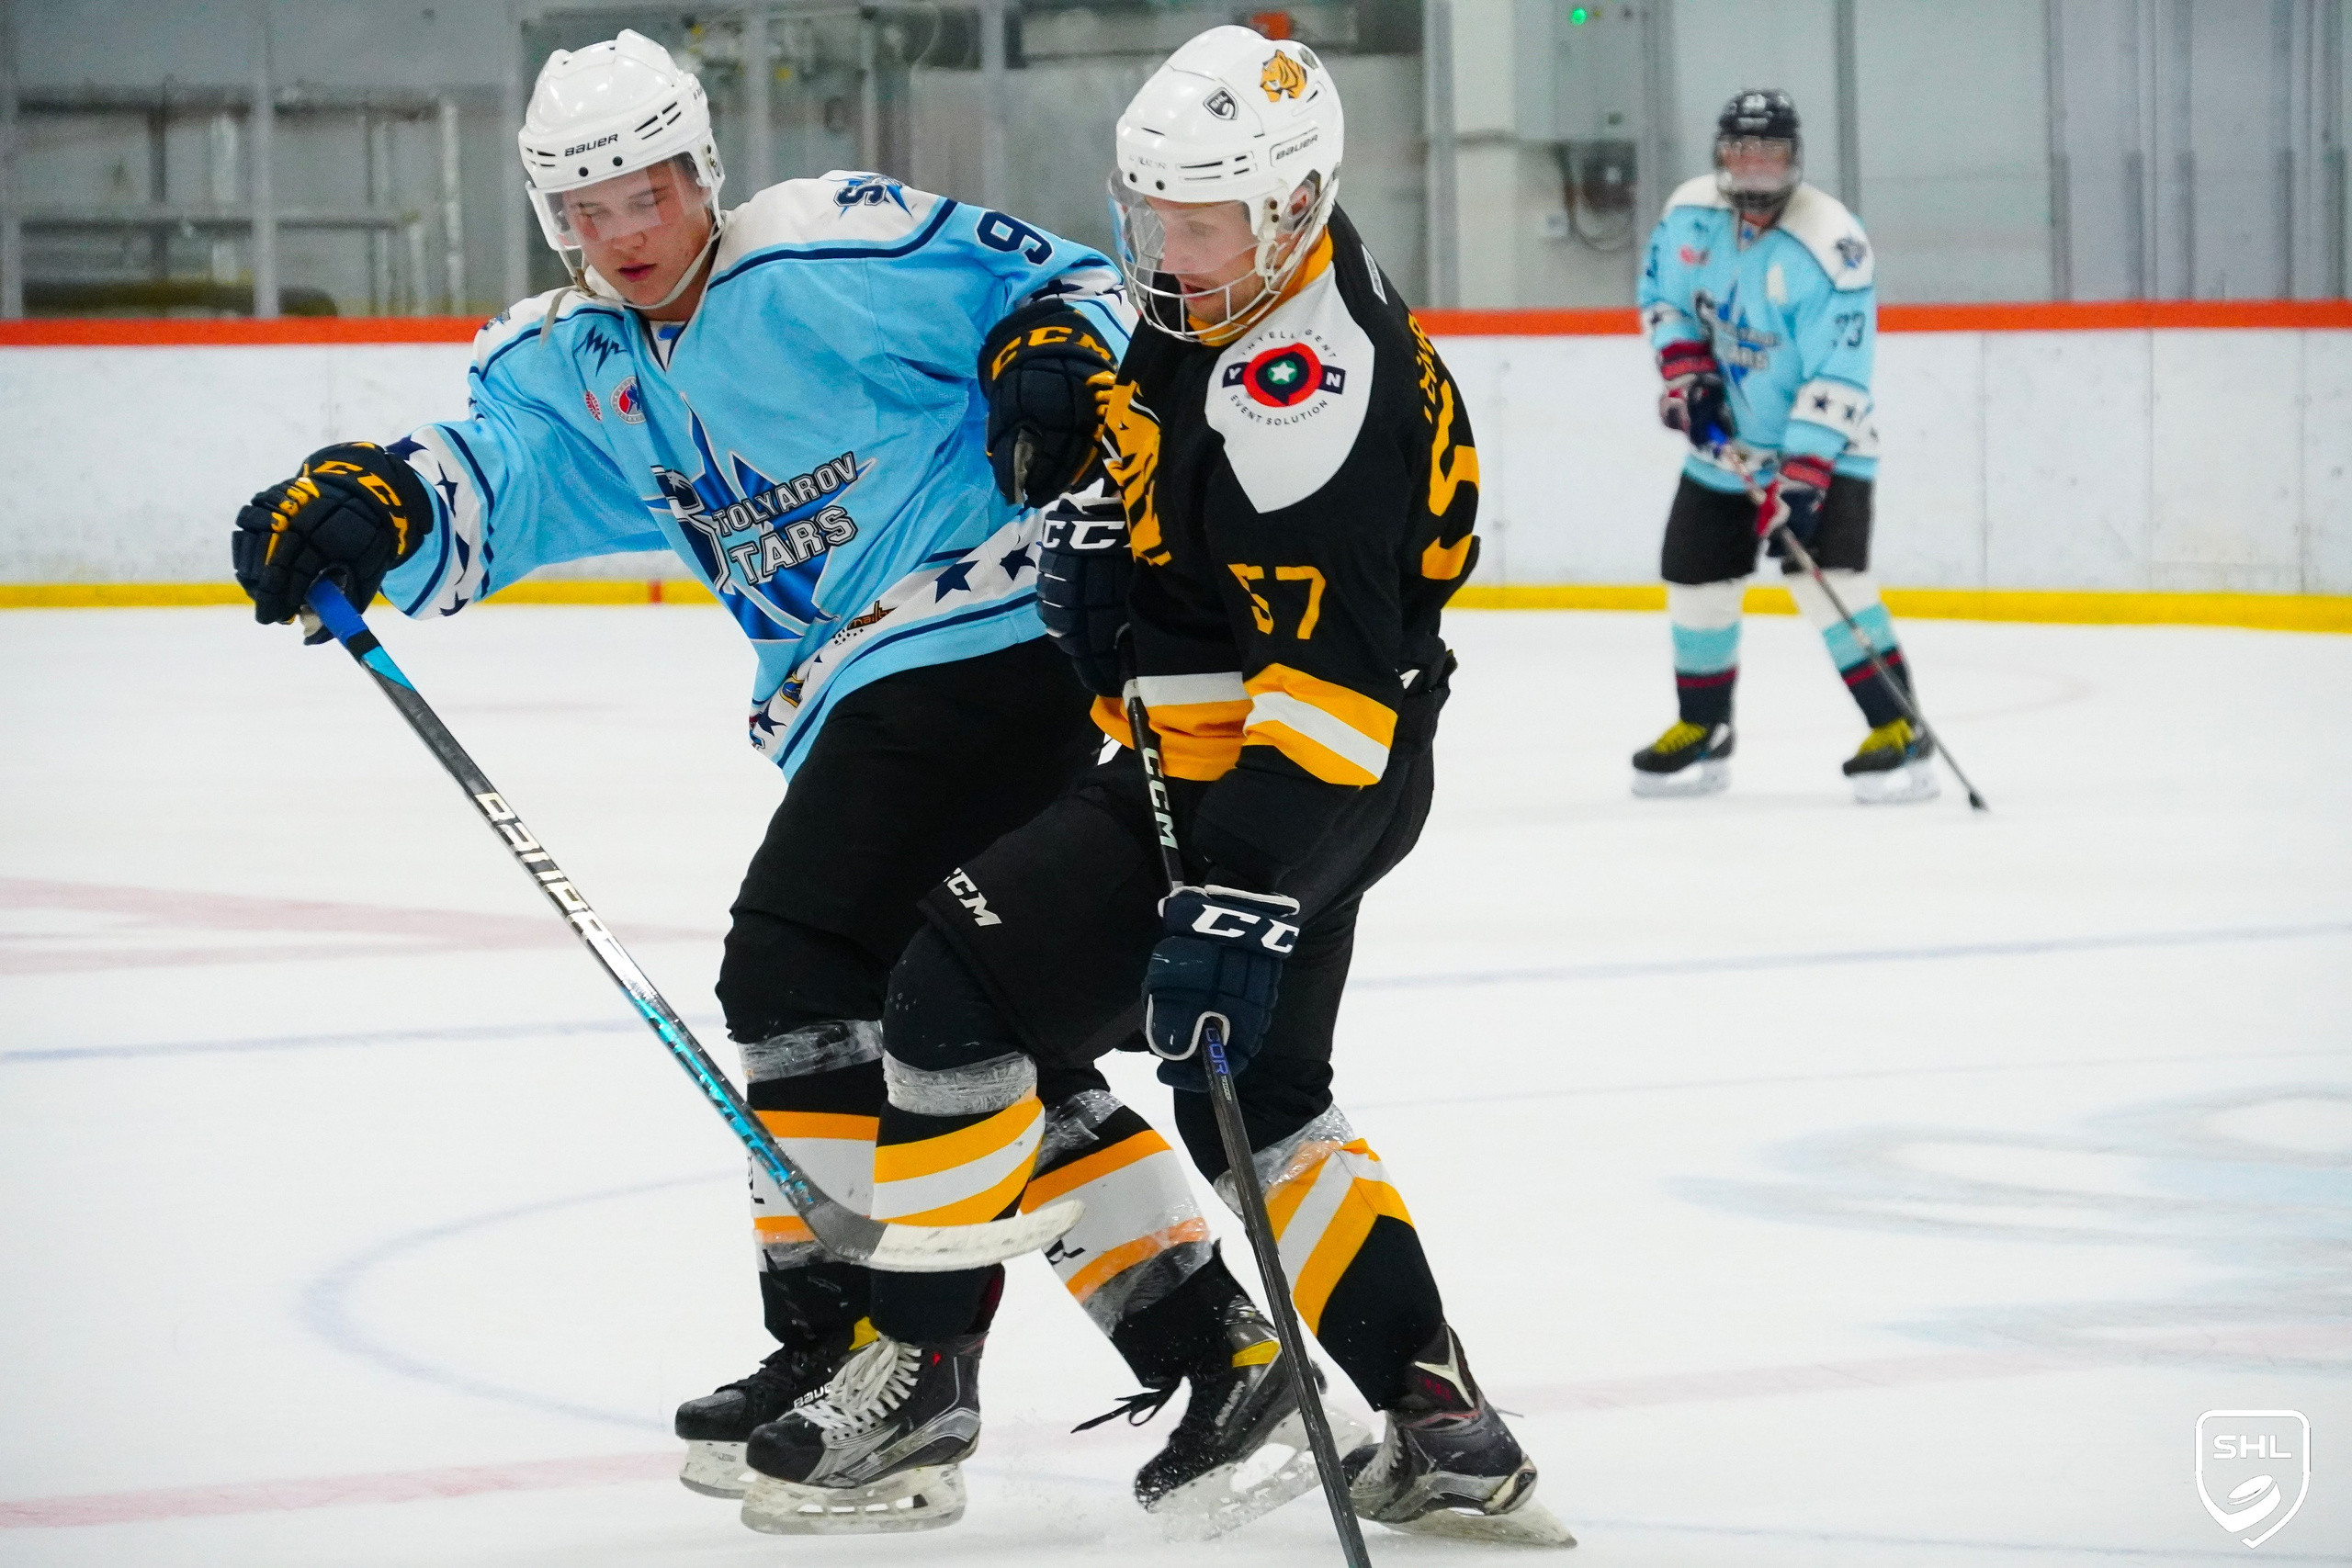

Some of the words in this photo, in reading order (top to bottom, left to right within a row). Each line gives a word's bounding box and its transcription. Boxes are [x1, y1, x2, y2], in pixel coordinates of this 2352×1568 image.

[564, 133, 618, 157] BAUER
[1275, 134, 1318, 161] BAUER
[1230, 394, 1263, 424] EVENT
[1265, 399, 1329, 426] SOLUTION
[1227, 562, 1327, 640] 57
[1142, 747, 1180, 851] CCM
[943, 867, 1003, 927] CM
